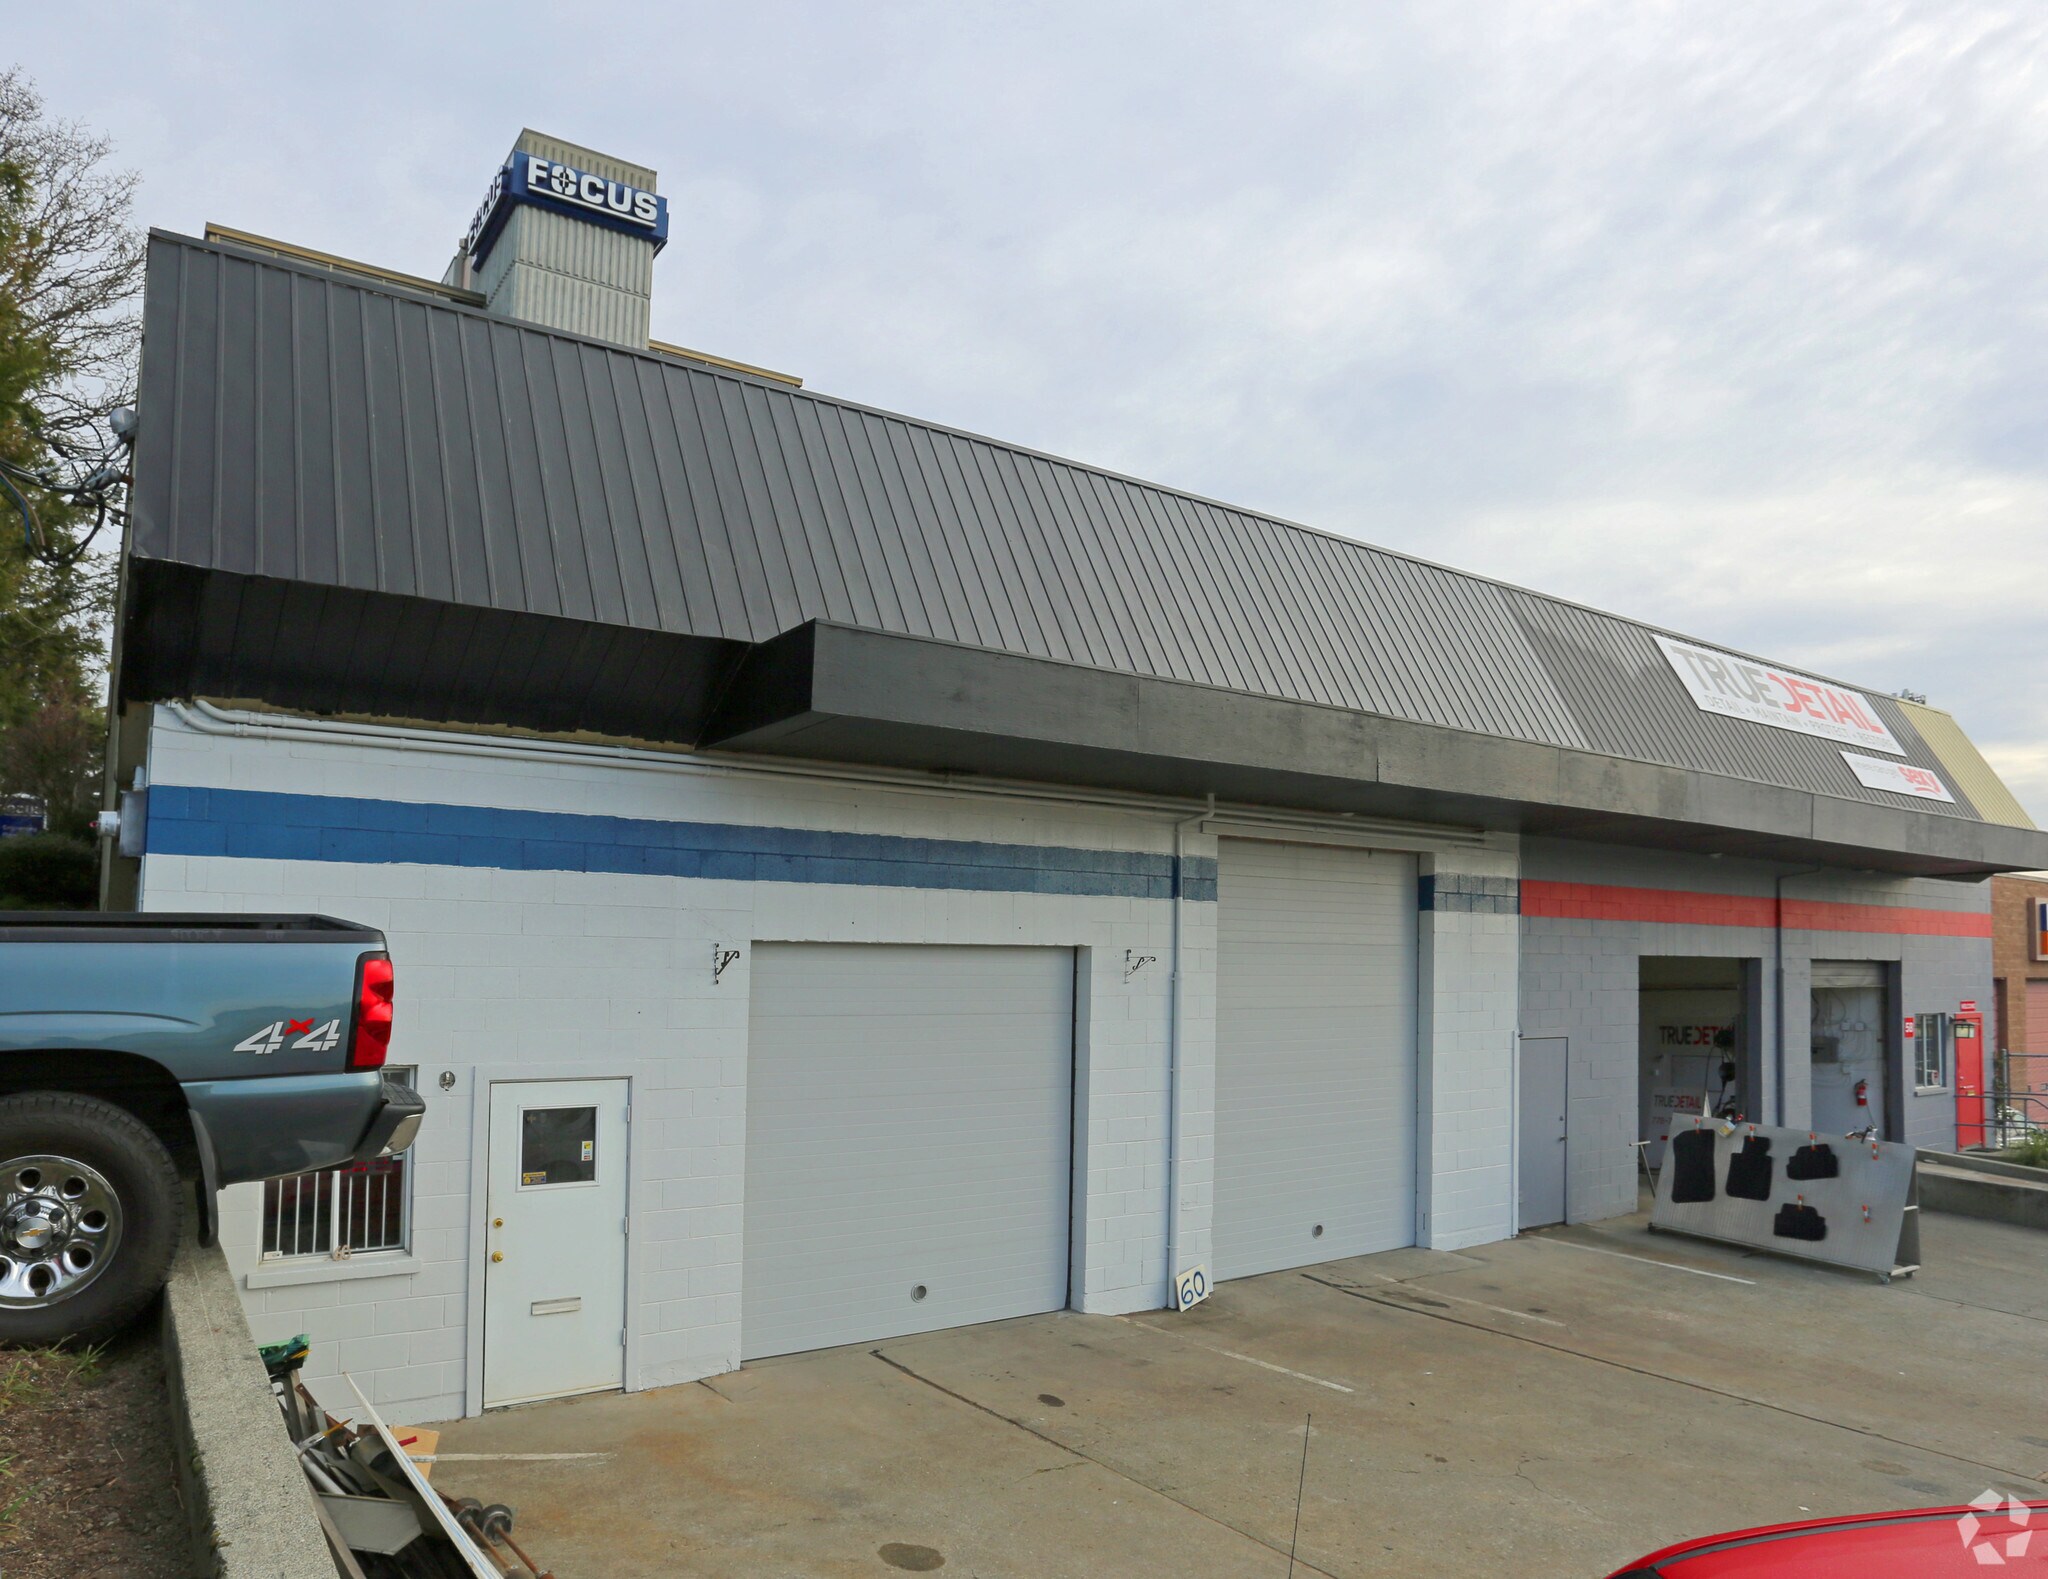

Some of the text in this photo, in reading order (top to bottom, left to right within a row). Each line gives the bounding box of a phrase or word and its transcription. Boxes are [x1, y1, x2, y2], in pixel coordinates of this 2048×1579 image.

[527, 156, 658, 221] FOCUS
[1659, 1026, 1735, 1045] TRUEDET
[1181, 1271, 1205, 1304] 60
